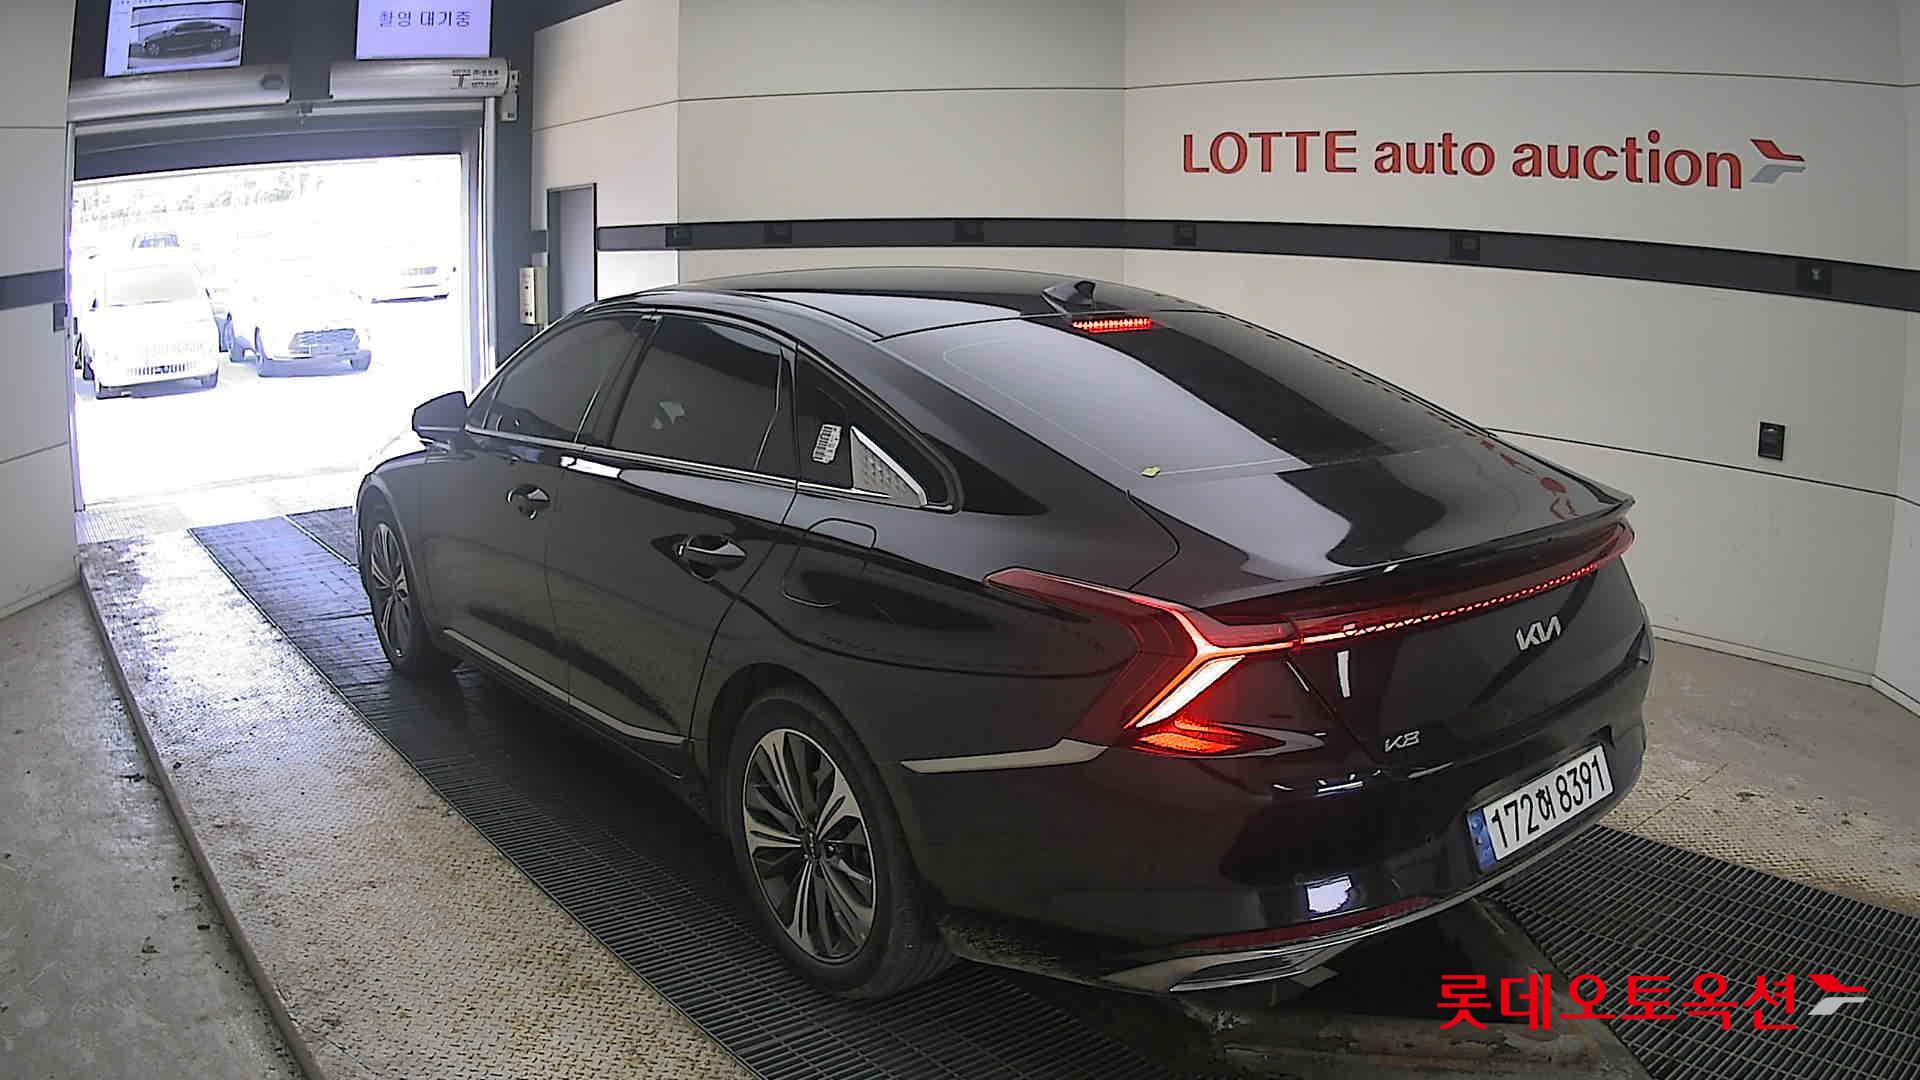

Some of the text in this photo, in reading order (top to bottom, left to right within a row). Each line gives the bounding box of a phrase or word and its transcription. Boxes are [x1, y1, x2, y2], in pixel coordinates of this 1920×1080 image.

[420, 11, 472, 28] 대기중
[1182, 130, 1742, 189] LOTTE auto auction
[1384, 730, 1421, 752] K8
